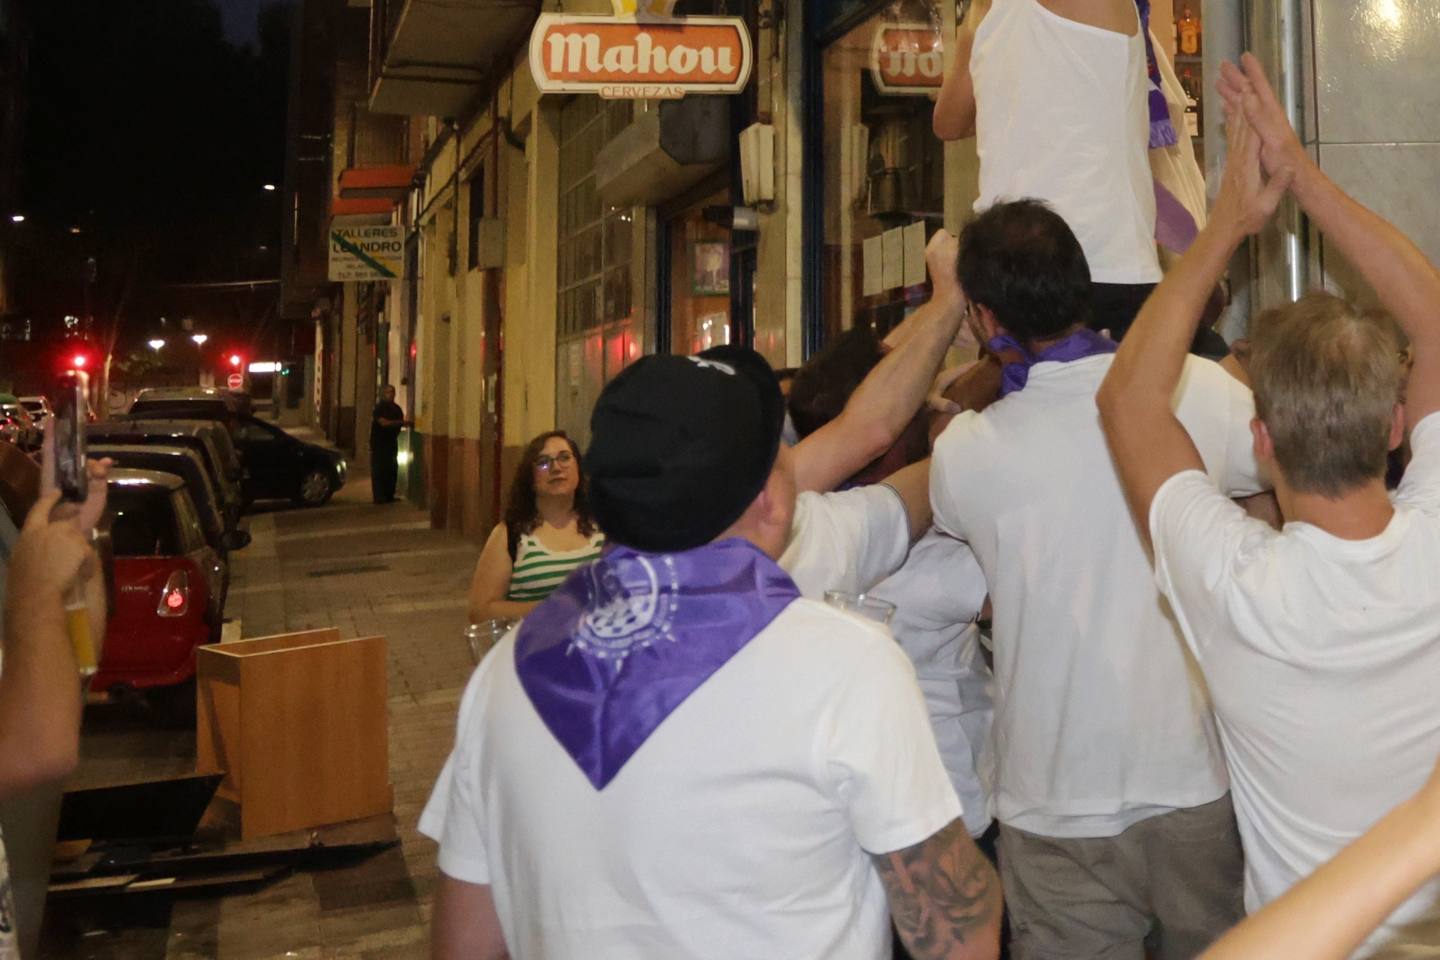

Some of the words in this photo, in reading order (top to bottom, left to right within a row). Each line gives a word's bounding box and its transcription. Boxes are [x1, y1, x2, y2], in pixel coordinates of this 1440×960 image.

[547, 32, 736, 75] Mahou
[601, 85, 683, 98] CERVEZAS
[335, 227, 398, 238] TALLERES
